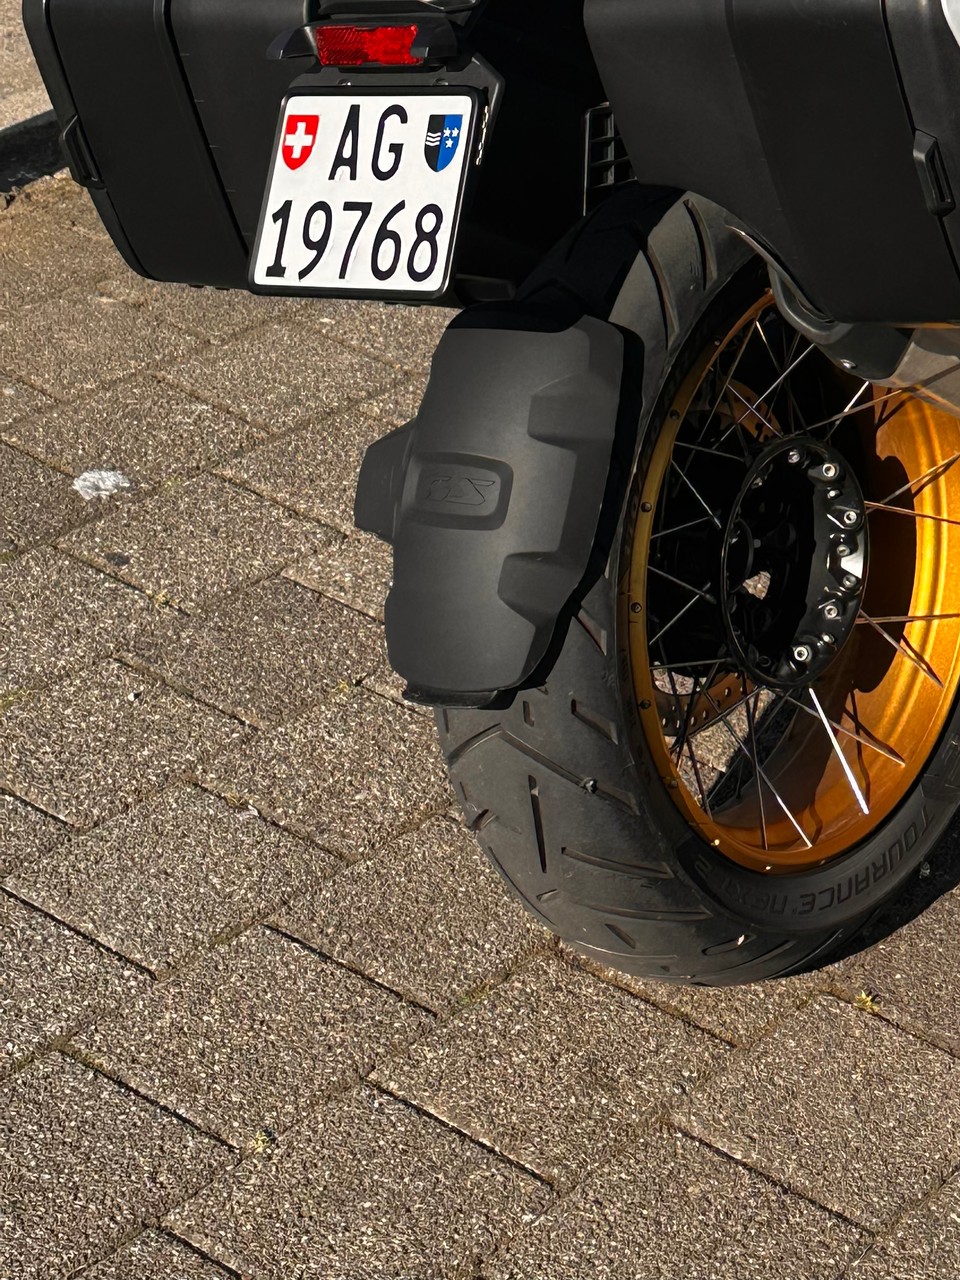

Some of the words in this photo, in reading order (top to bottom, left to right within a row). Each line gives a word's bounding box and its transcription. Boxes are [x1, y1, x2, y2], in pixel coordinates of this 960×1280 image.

[328, 103, 408, 182] AG
[265, 199, 444, 283] 19768
[799, 805, 935, 915] TOURANCE
